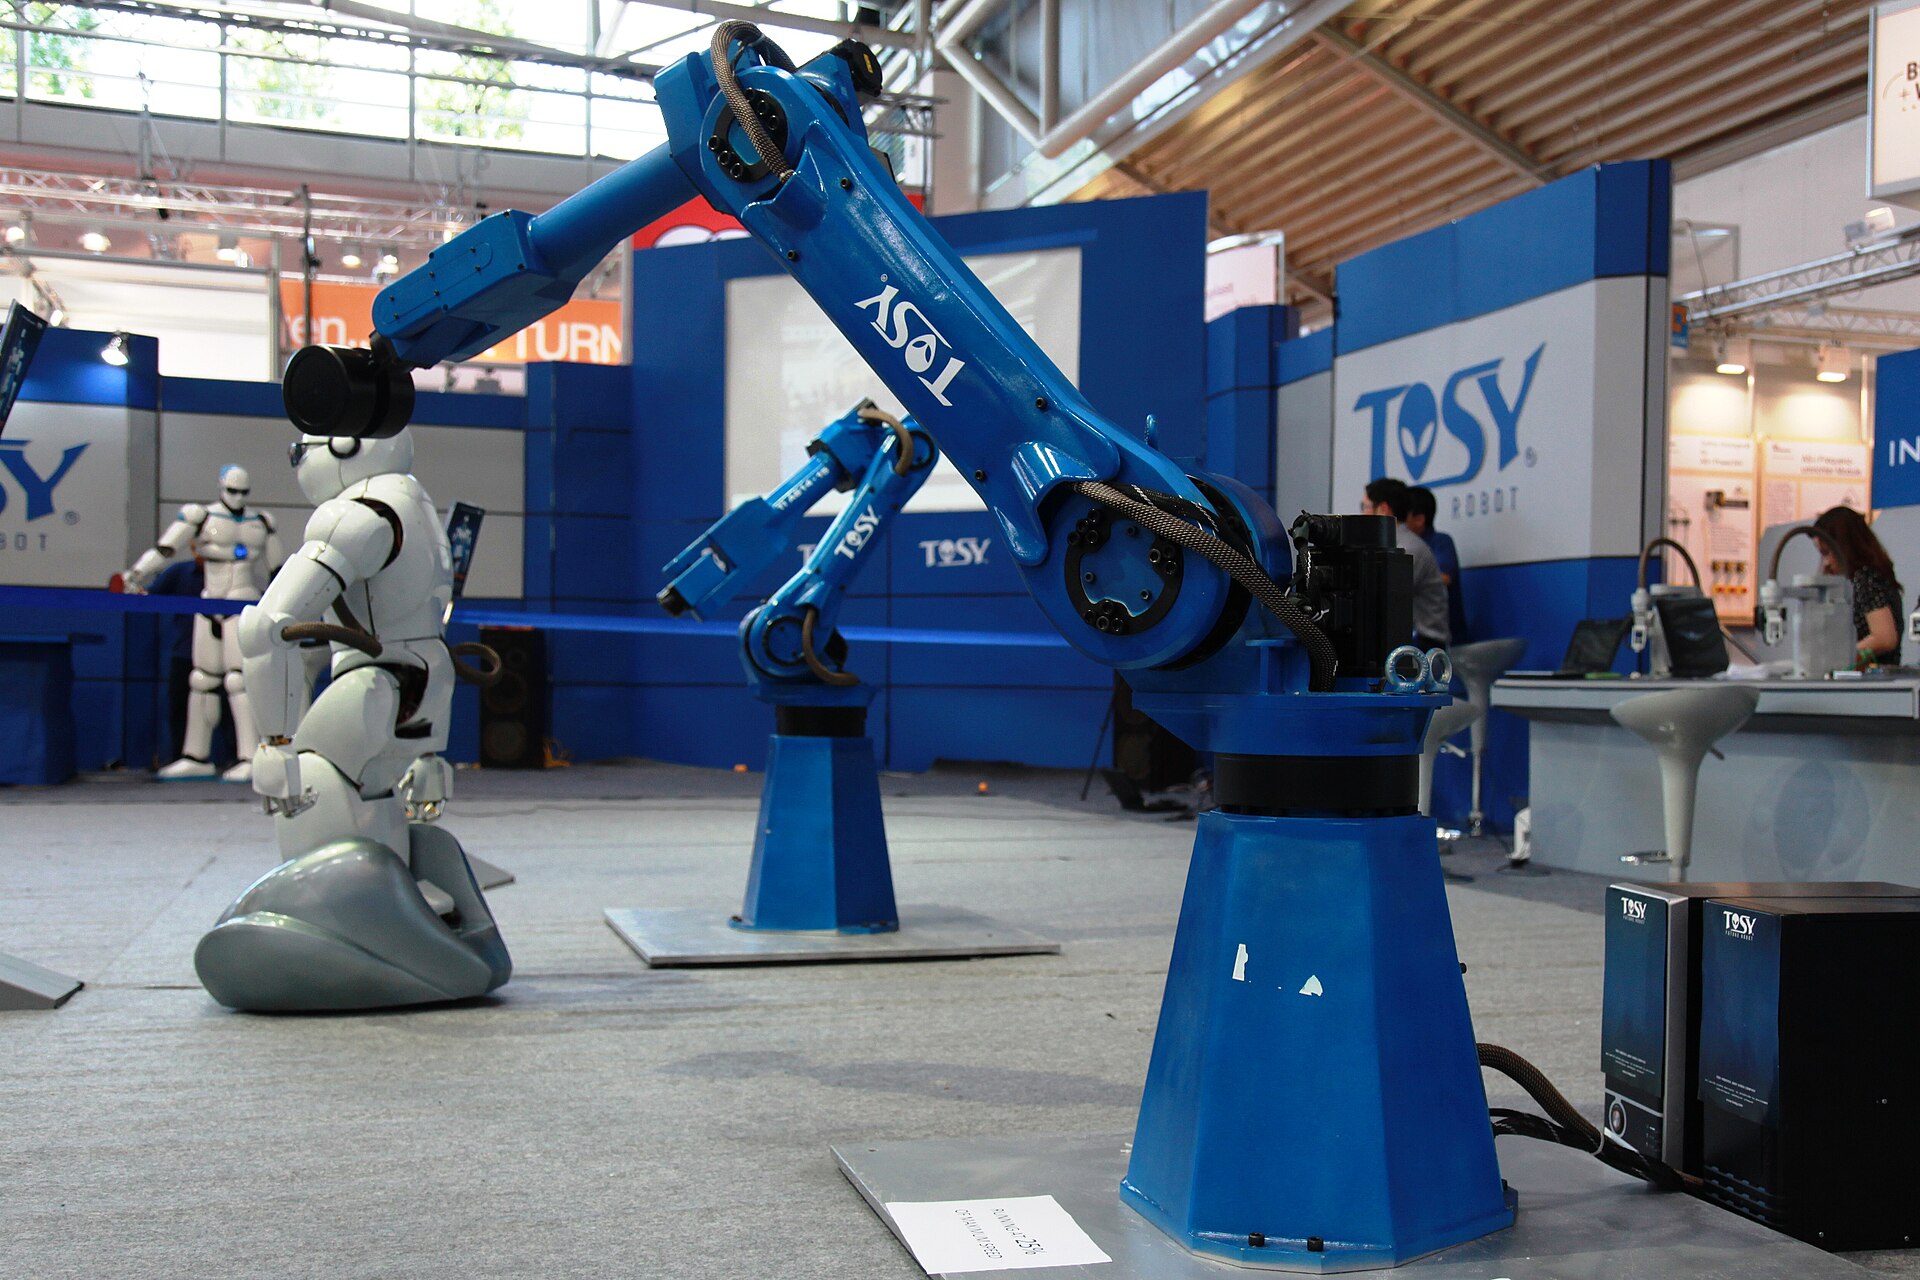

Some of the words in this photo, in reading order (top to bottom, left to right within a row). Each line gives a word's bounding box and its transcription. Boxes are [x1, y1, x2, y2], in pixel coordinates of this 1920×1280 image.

[854, 284, 966, 407] TOSY
[1354, 341, 1547, 489] TOSY
[0, 438, 92, 523] Y
[1451, 486, 1520, 518] ROBOT
[834, 504, 880, 560] TOSY
[918, 536, 991, 568] TOSY
[1621, 897, 1647, 919] TOSY
[1723, 910, 1757, 935] TOSY
[979, 1242, 1003, 1259] SPEED
[1015, 1239, 1047, 1256] 25%
